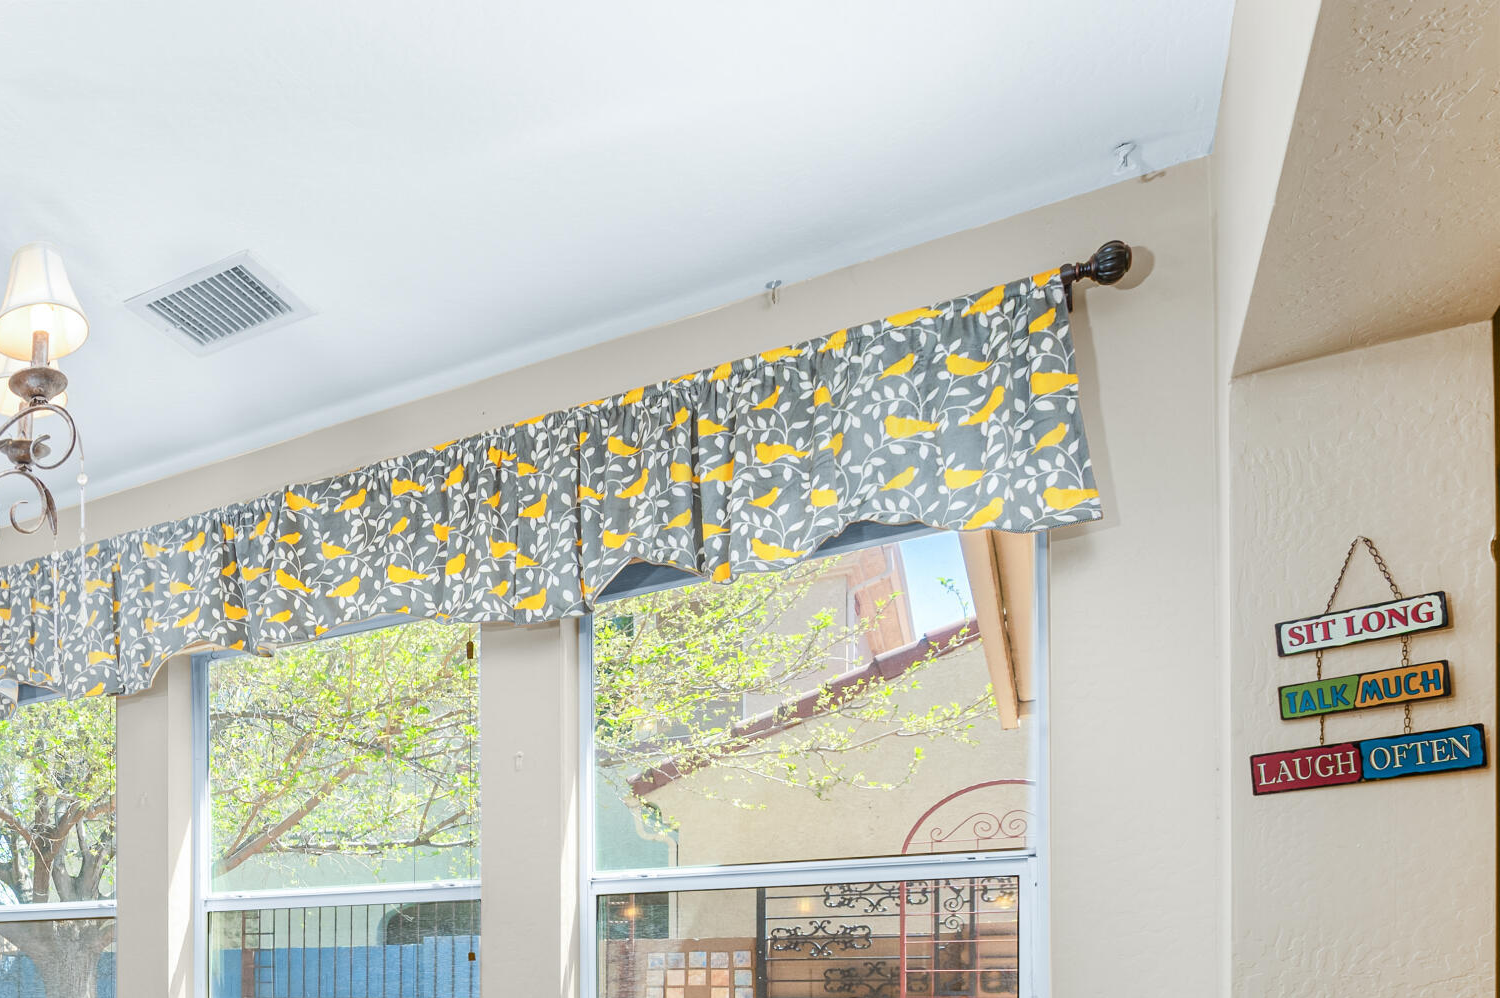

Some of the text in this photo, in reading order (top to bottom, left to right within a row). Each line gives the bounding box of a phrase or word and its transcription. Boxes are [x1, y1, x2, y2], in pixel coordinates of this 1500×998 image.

[1288, 601, 1436, 647] SIT LONG
[1285, 669, 1442, 714] TALK MUCH
[1257, 734, 1472, 786] LAUGH OFTEN
